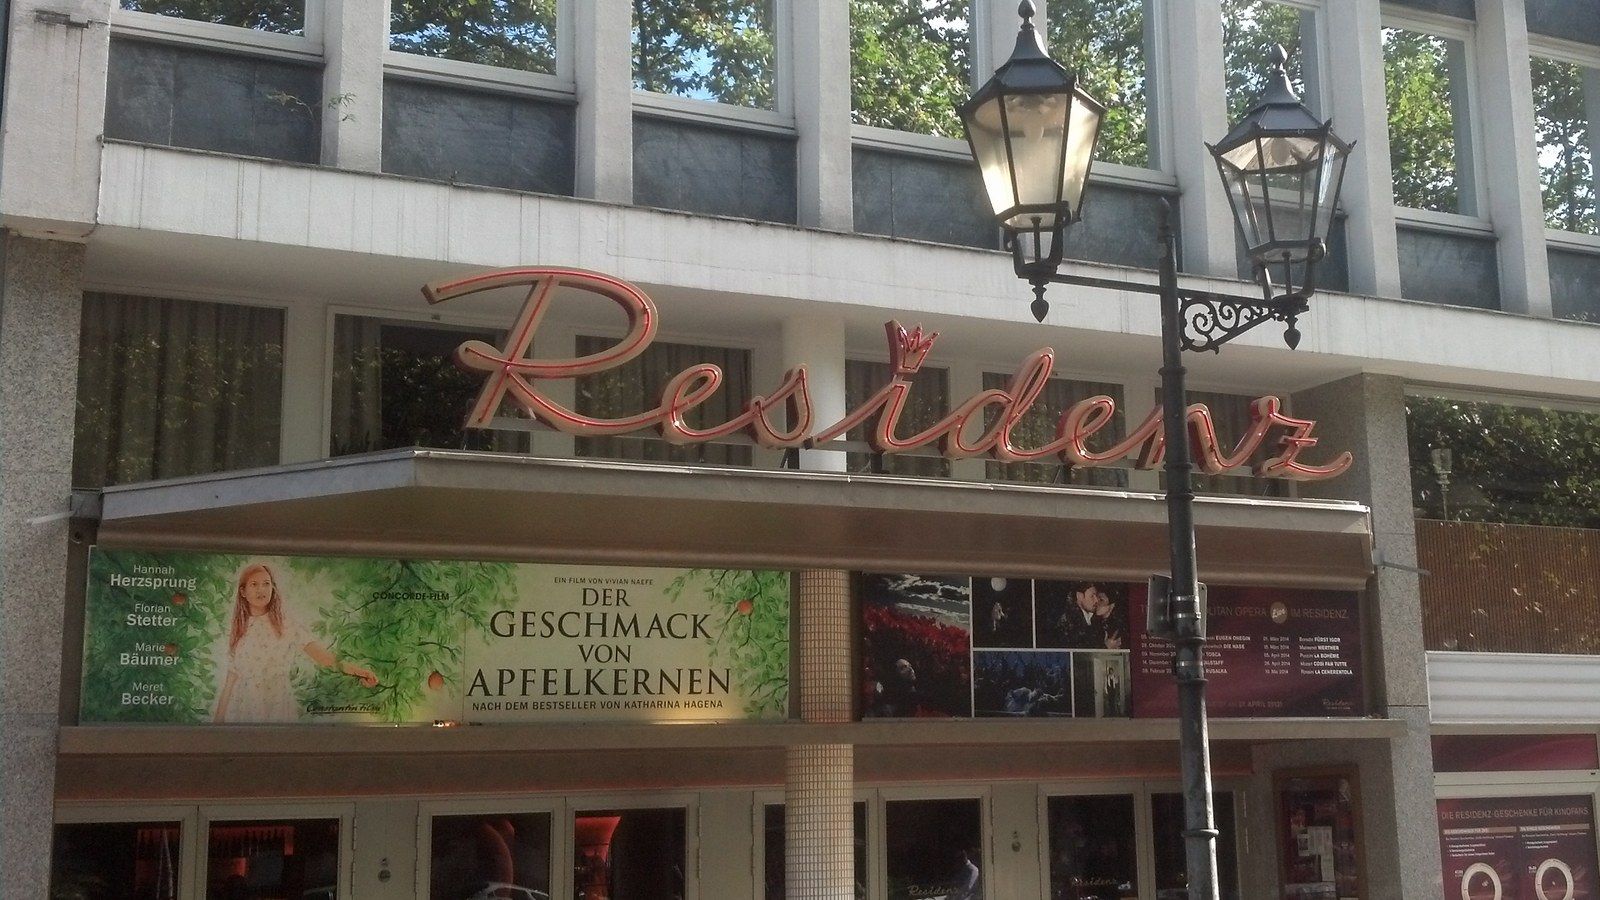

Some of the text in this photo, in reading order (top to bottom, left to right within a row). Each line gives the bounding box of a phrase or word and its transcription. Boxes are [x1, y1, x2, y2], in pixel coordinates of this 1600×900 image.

[423, 265, 1354, 482] Residenz
[133, 564, 175, 575] Hannah
[110, 573, 197, 590] Herzsprung
[554, 576, 568, 584] EIN
[568, 577, 586, 585] FILM
[587, 577, 604, 585] VON
[372, 591, 450, 601] CONCORDE-FILM
[582, 587, 631, 607] DER
[134, 603, 171, 614] Florian
[126, 613, 178, 627] Stetter
[489, 609, 713, 639] GESCHMACK
[135, 642, 166, 652] Marie
[577, 643, 632, 664] VON
[119, 652, 180, 666] Bäumer
[132, 682, 164, 692] Meret
[465, 667, 731, 697] APFELKERNEN
[121, 692, 174, 705] Becker
[472, 700, 724, 711] NACH DEM BESTSELLER VON KATHARINA HAGENA
[1441, 810, 1454, 820] DIE
[1538, 806, 1553, 817] FÜR
